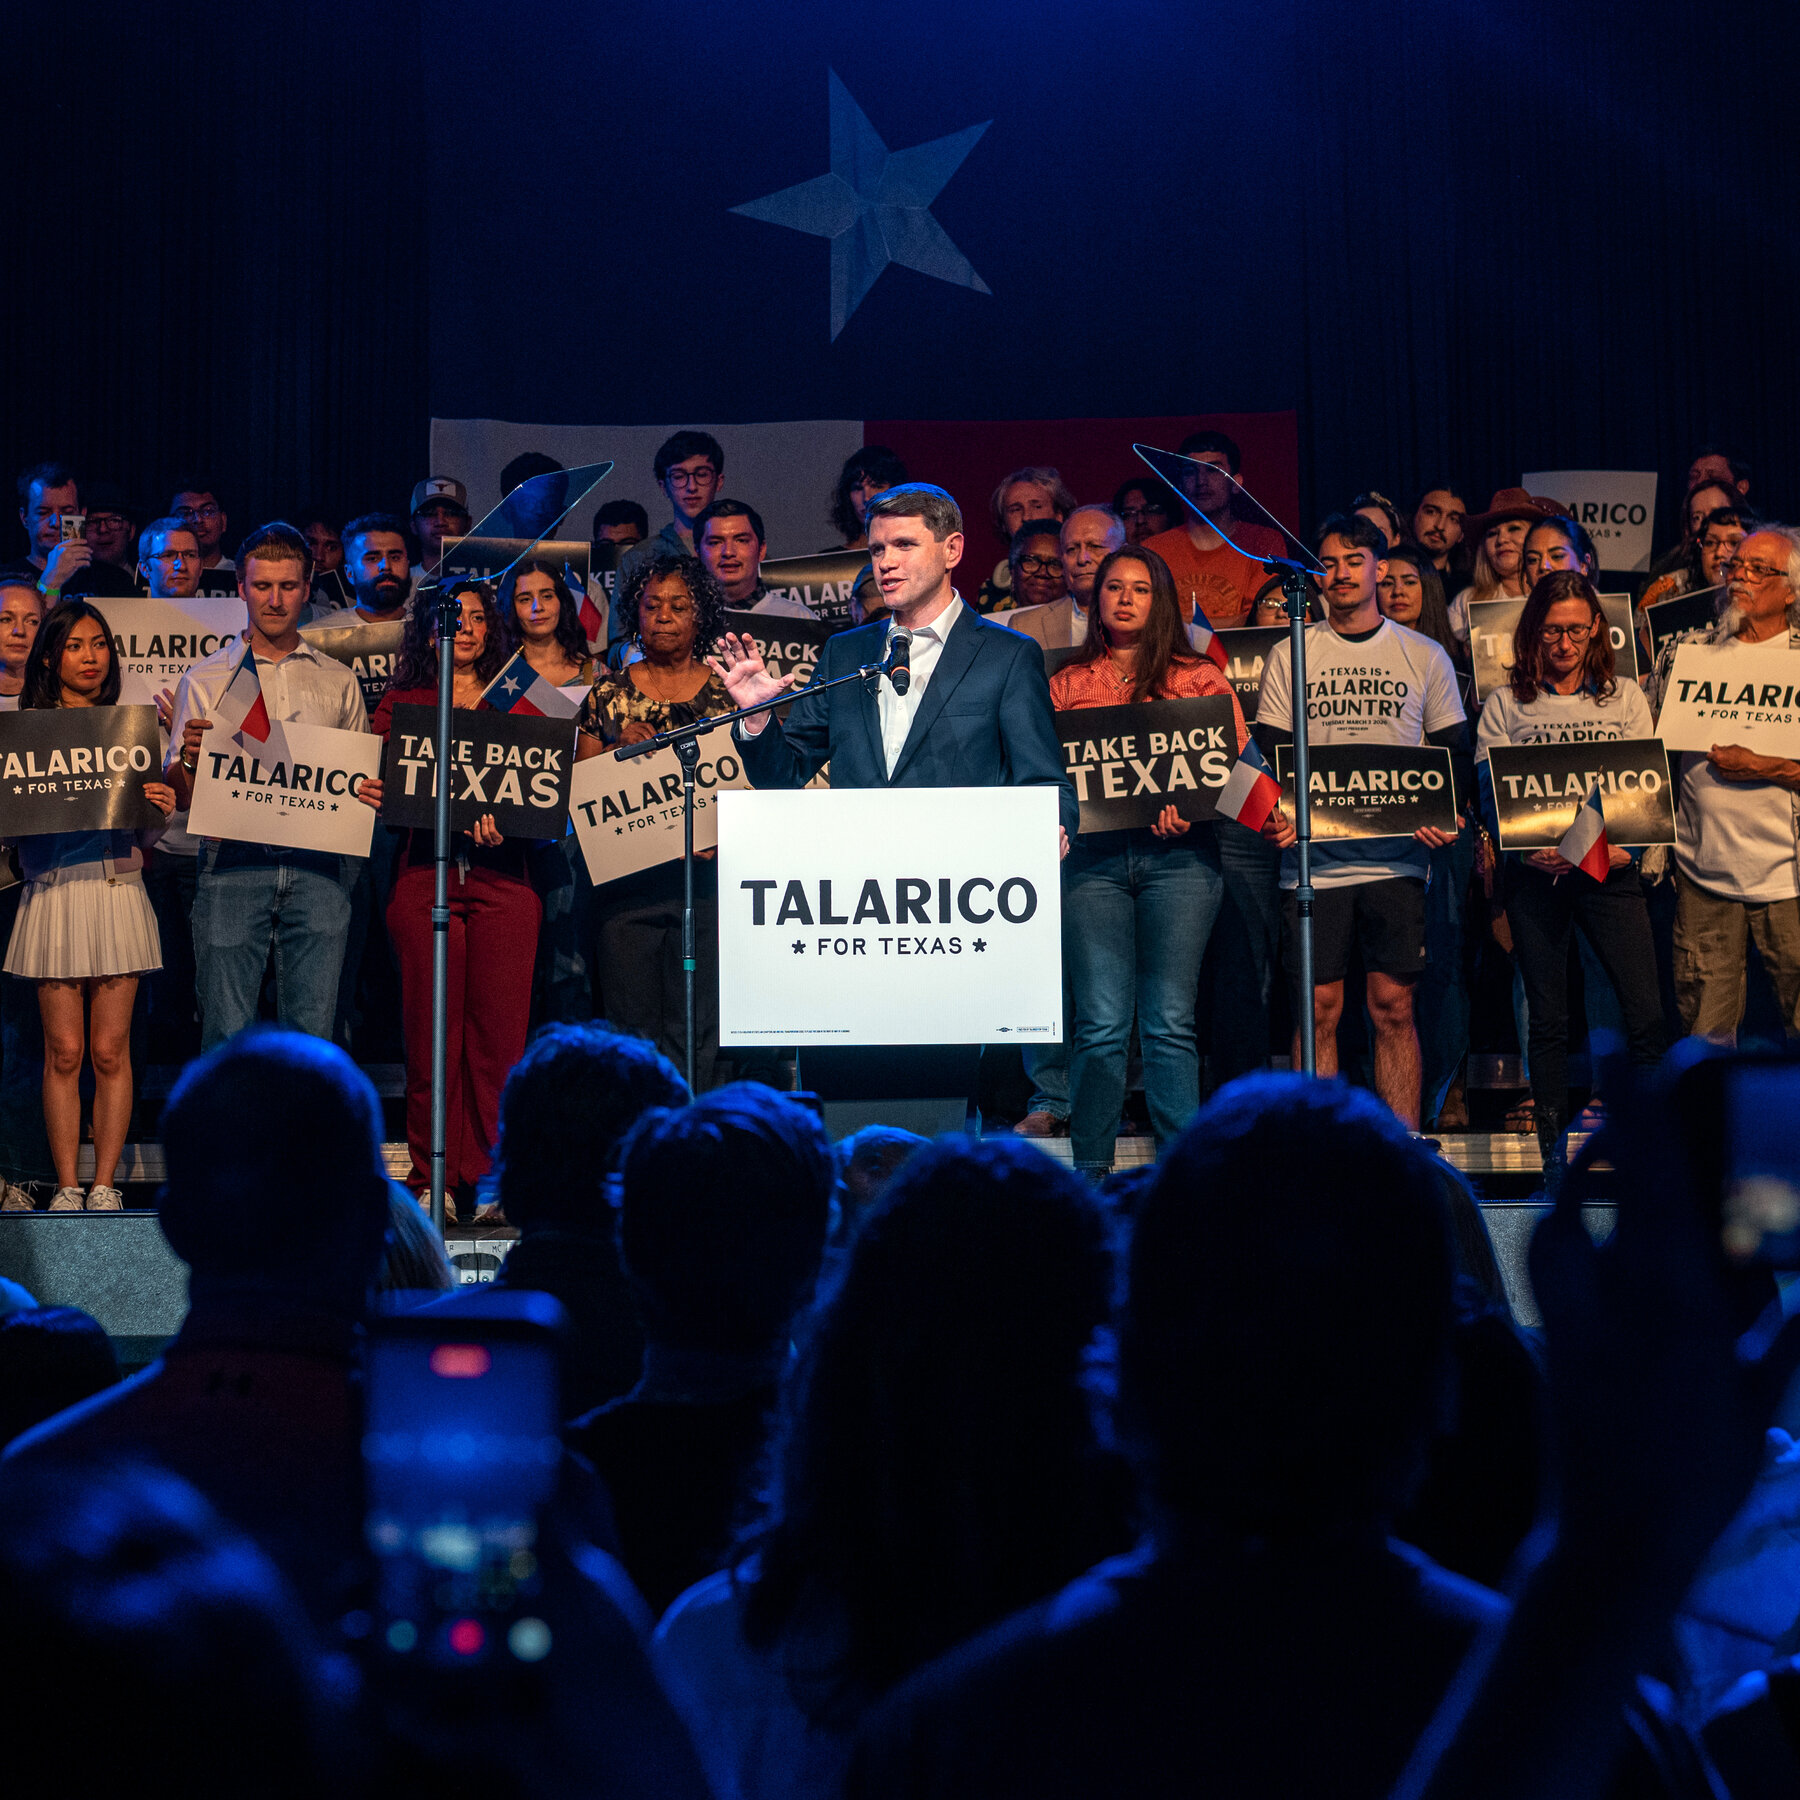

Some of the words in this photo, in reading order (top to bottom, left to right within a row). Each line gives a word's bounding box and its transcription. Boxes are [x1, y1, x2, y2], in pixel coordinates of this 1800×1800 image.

[1568, 503, 1647, 526] ARICO
[1589, 528, 1611, 538] XAS
[770, 581, 853, 607] TALAR
[113, 634, 237, 659] ALARIC
[755, 639, 820, 663] BACK
[128, 664, 153, 674] FOR
[1329, 667, 1367, 676] TEXAS
[1370, 667, 1382, 676] IS
[1235, 682, 1260, 693] FOR
[1306, 679, 1408, 699] TALARICO
[1677, 679, 1800, 709] TALARI
[1306, 699, 1406, 719] COUNTRY
[1711, 709, 1739, 720] FOR
[1745, 711, 1792, 724] TEXAS
[1063, 735, 1138, 764] TAKE
[1149, 726, 1228, 755] BACK
[0, 745, 151, 780] ALARICO
[485, 743, 563, 771] BACK
[28, 782, 57, 795] FOR
[63, 778, 112, 792] TEXAS
[208, 752, 369, 799] TALARICO
[1066, 750, 1231, 802] TEXAS
[1287, 770, 1444, 793] ALARICO
[1502, 769, 1662, 799] TALARICO
[246, 791, 273, 804] FOR
[280, 795, 325, 811] TEXAS
[577, 755, 740, 828] TALARCO
[1328, 796, 1356, 807] FOR
[1361, 795, 1406, 805] TEXAS
[628, 815, 656, 832] FOR
[740, 877, 1038, 926] TALARICO
[818, 938, 867, 955] FOR
[878, 937, 962, 955] TEXAS
